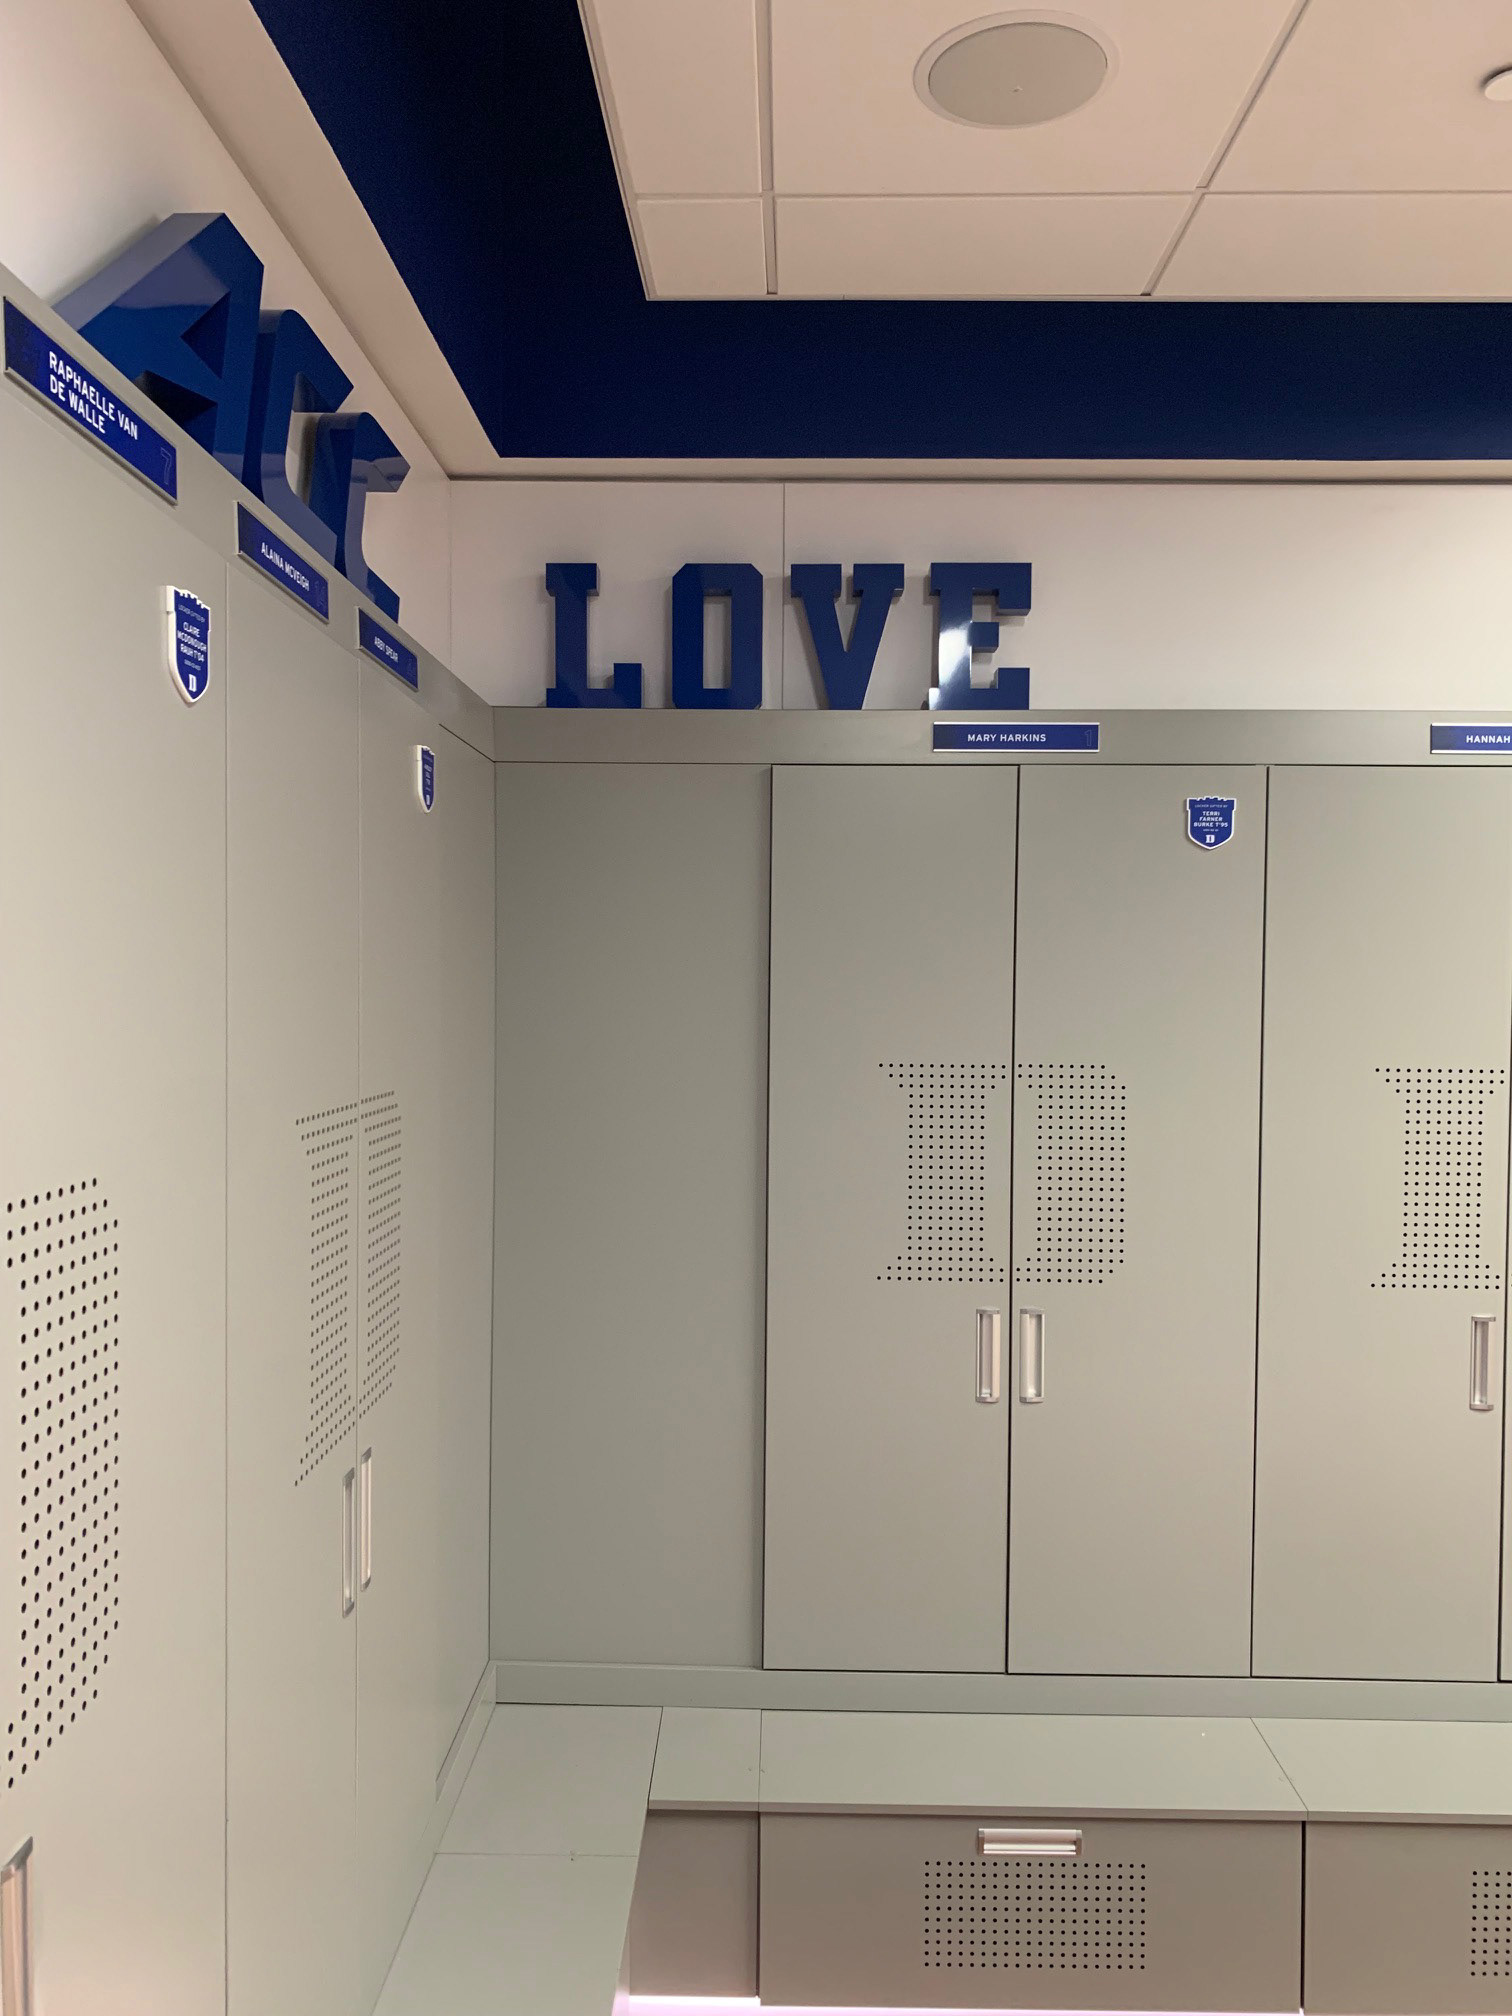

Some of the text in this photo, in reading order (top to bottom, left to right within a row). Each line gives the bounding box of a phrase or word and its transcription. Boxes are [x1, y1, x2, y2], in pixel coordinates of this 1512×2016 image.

[49, 351, 138, 440] RAPHAELLE VAN
[50, 374, 105, 433] DE WALLE
[261, 542, 284, 571] ALAINA
[183, 622, 200, 637] CLAIRE
[545, 563, 1032, 711] LOVE
[967, 733, 1047, 742] MARY HARKINS
[1465, 735, 1511, 744] HANNAH
